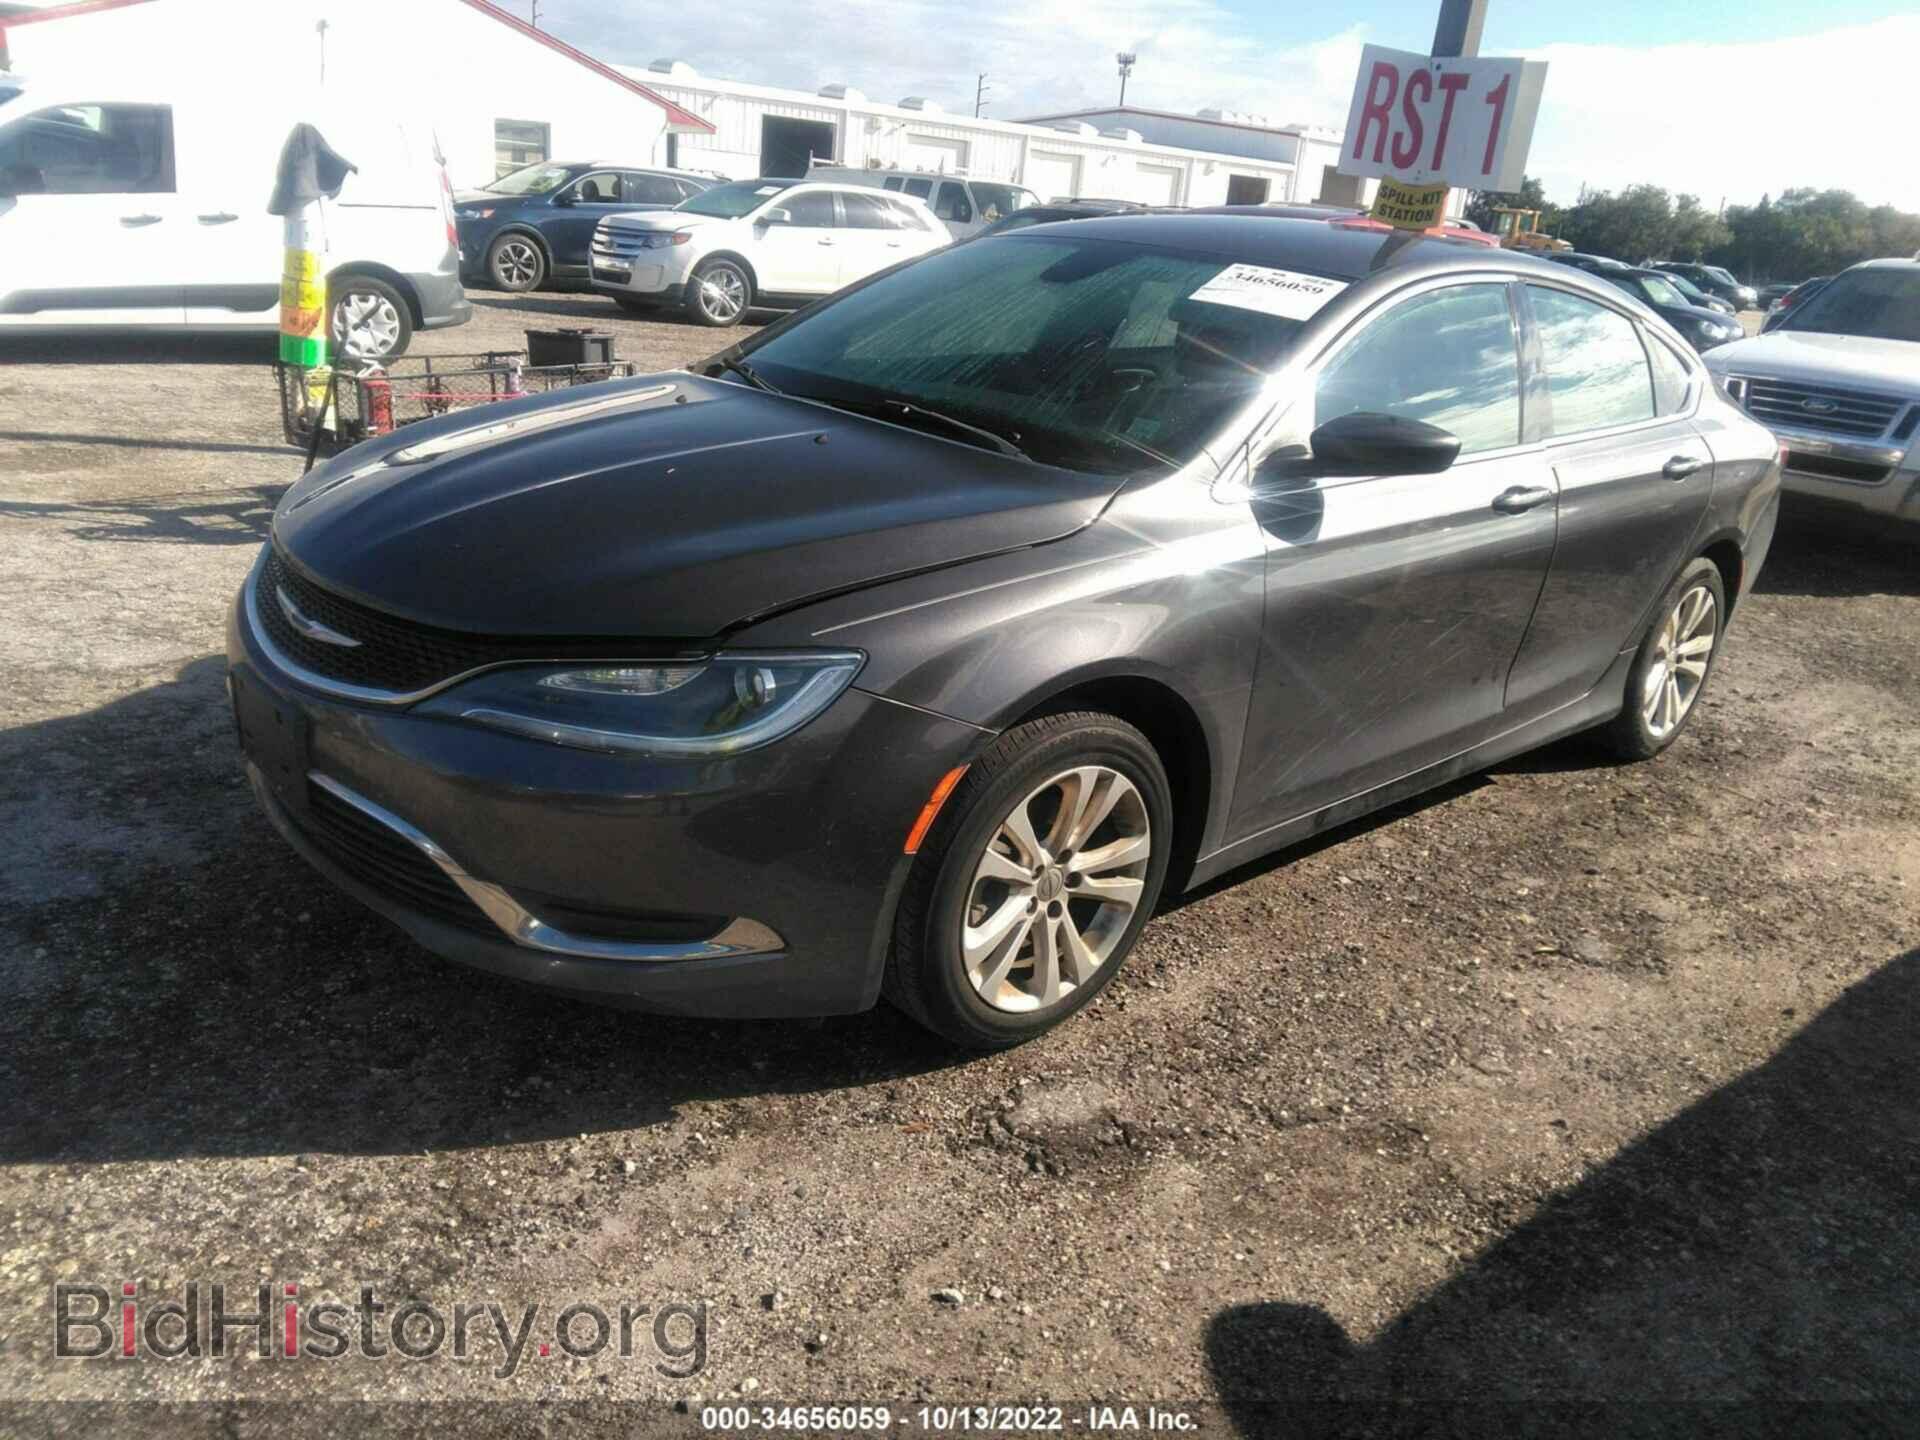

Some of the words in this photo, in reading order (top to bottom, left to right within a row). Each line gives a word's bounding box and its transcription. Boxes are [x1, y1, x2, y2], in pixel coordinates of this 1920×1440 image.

[1353, 61, 1472, 171] RST
[1481, 73, 1511, 175] 1
[1378, 184, 1443, 206] SPILL-KIT
[1377, 203, 1434, 222] STATION
